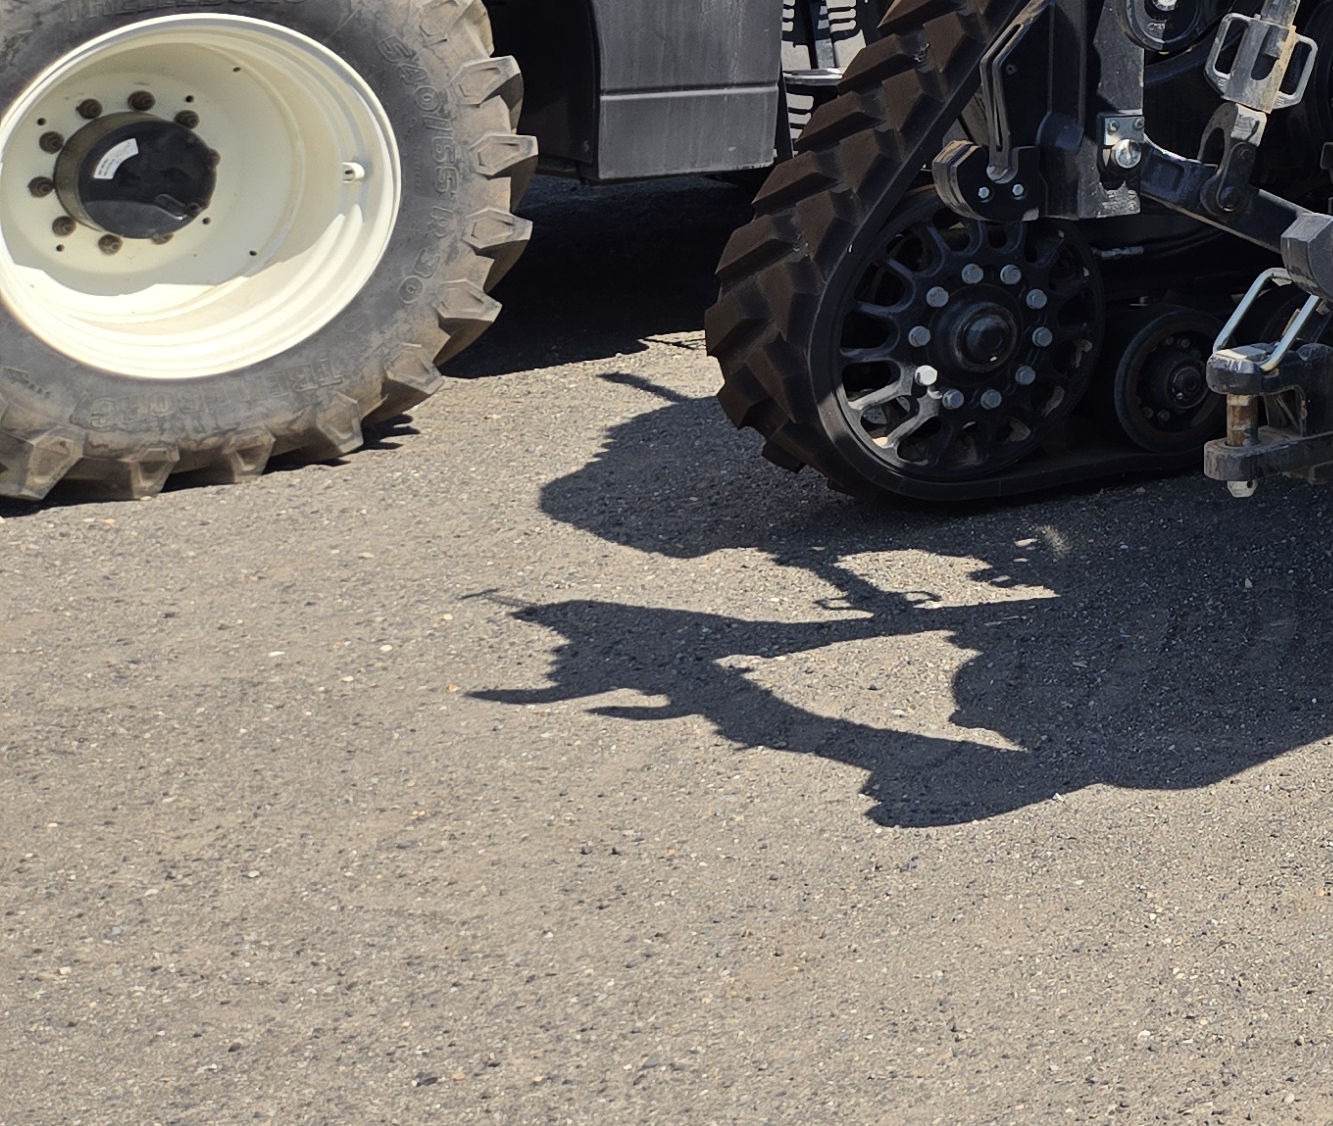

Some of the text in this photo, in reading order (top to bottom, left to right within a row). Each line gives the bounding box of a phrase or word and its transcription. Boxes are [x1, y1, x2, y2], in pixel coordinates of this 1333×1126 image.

[376, 35, 457, 304] 540/65 R 30
